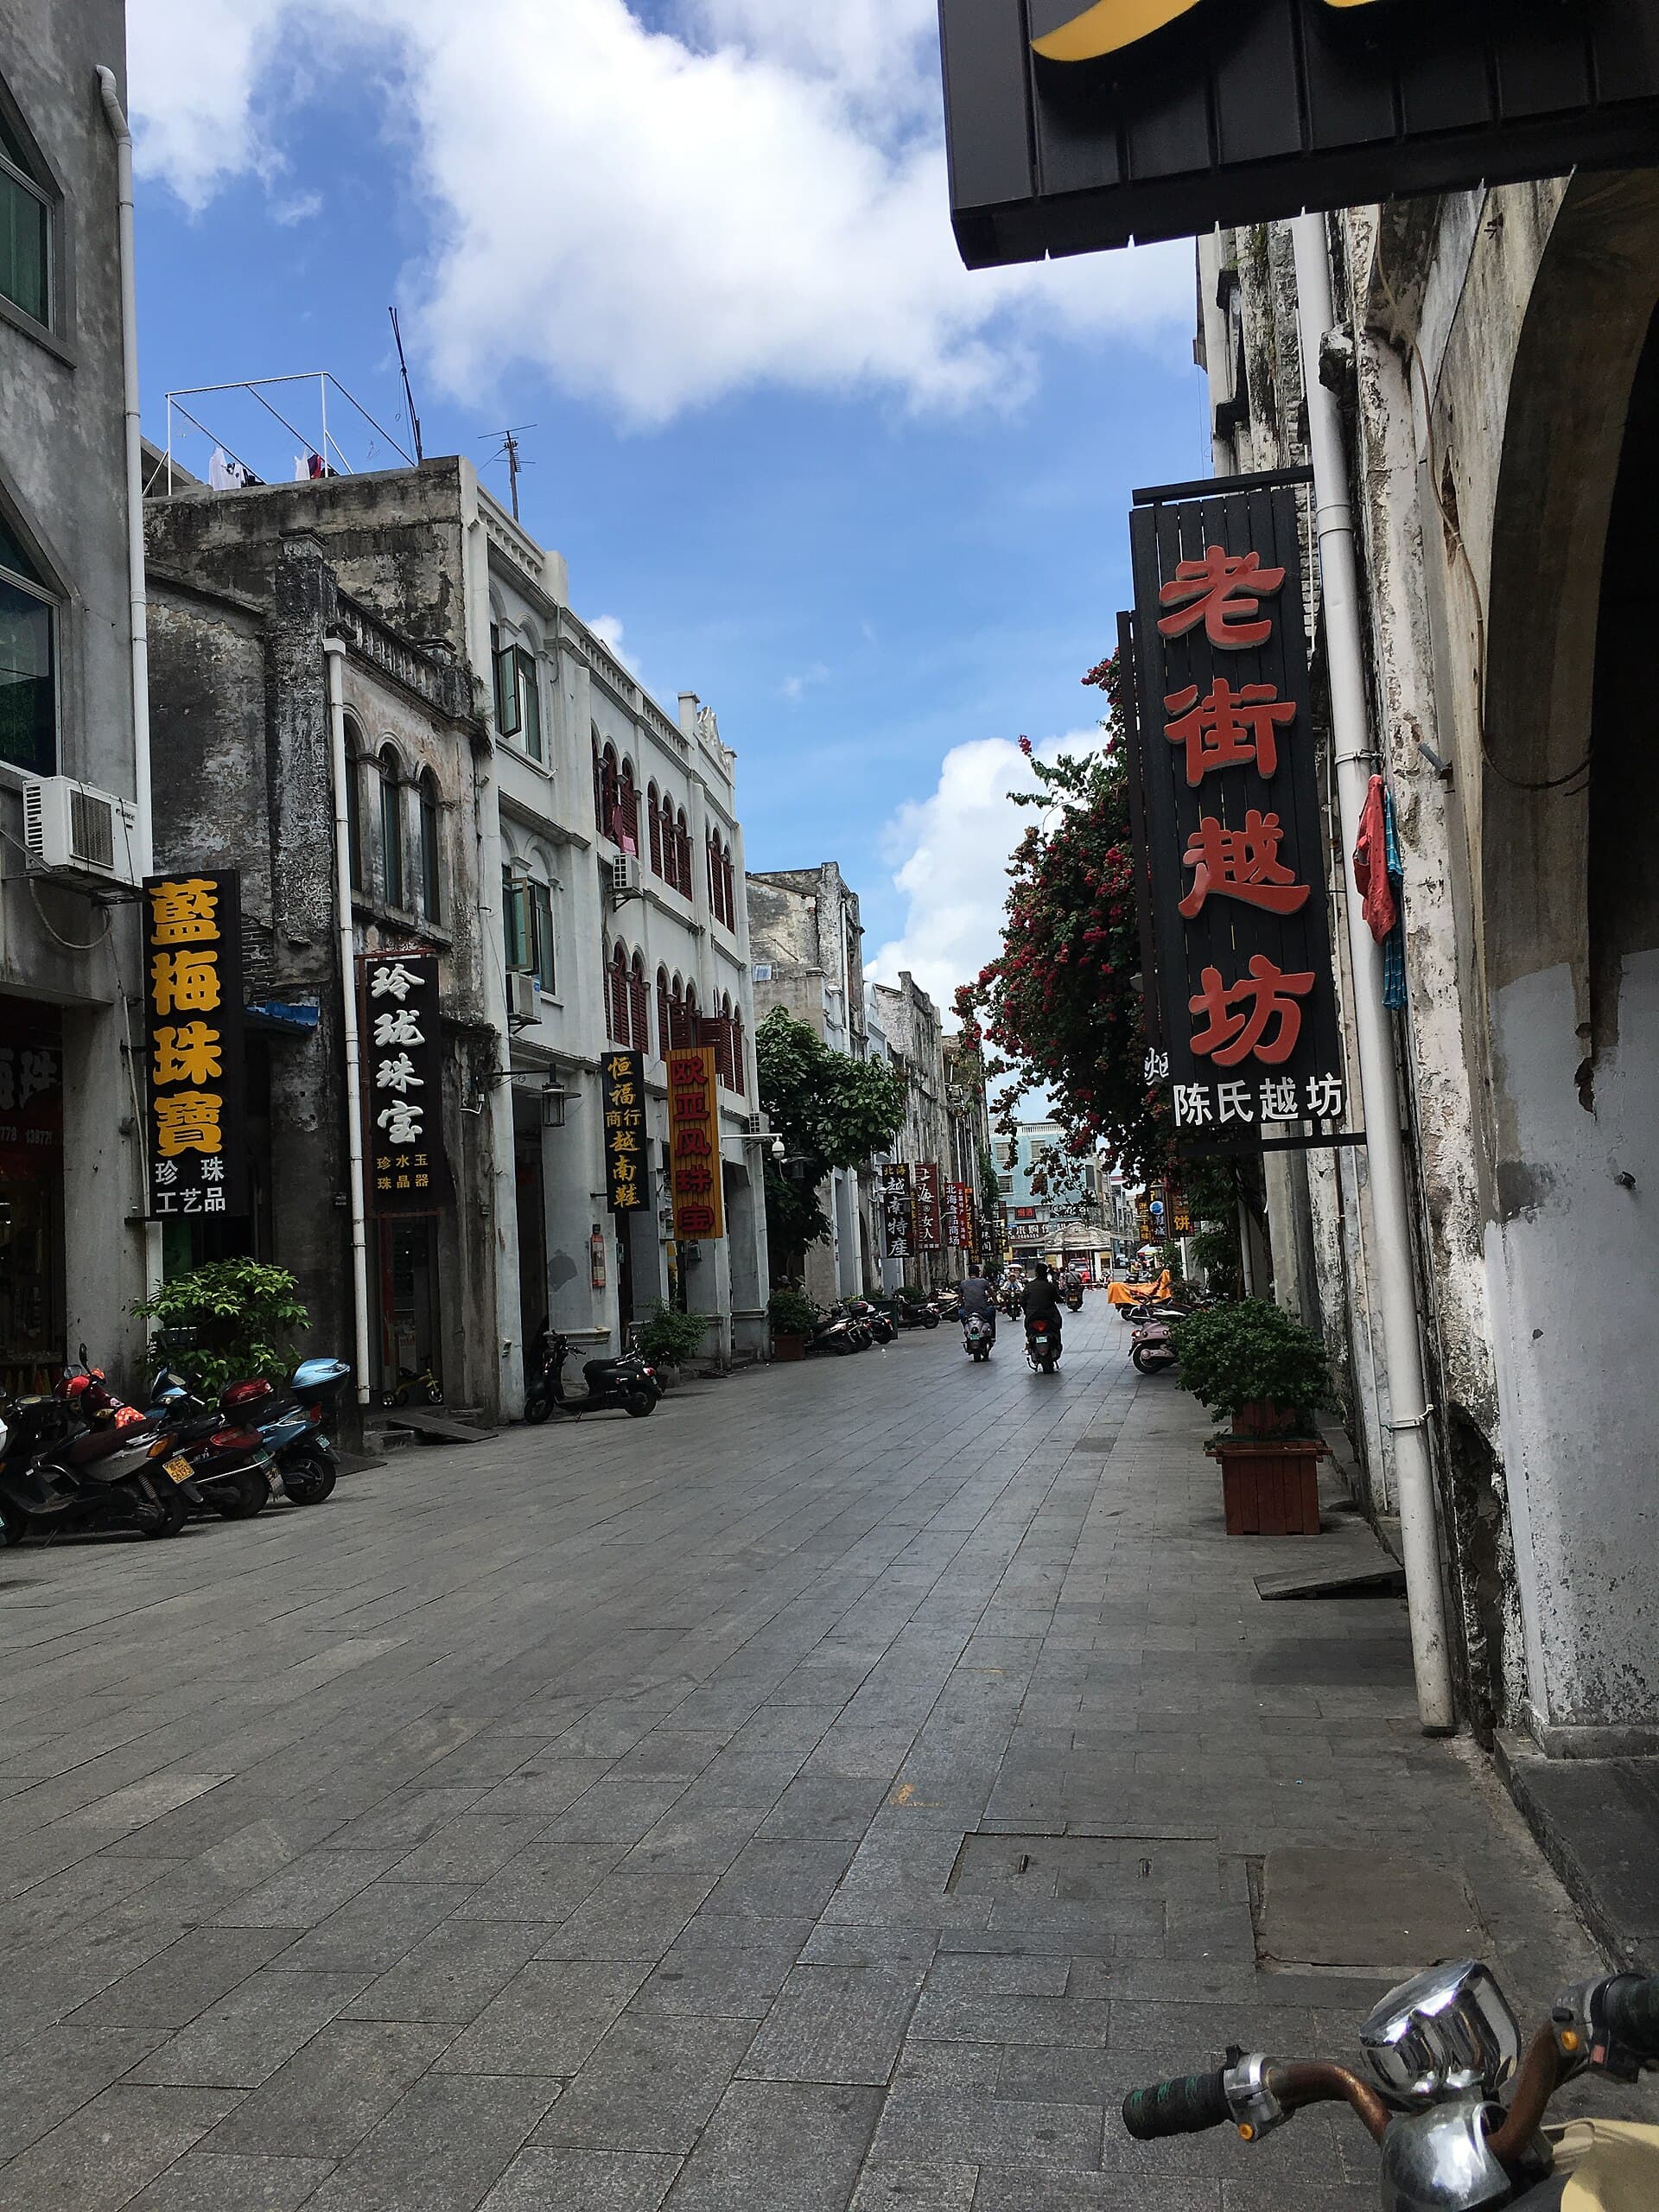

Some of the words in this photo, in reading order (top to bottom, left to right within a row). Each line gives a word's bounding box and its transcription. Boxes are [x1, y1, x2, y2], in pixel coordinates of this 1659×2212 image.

[1159, 544, 1316, 1068] 老街越坊
[149, 878, 223, 1157] 藍梅珠寶
[372, 963, 425, 1144] 玲珑珠宝
[606, 1109, 643, 1128] 商行
[1173, 1072, 1343, 1127] 陈氏越坊
[155, 1156, 225, 1185] 珍珠
[608, 1130, 640, 1209] 越南鞋
[670, 1054, 715, 1232] 欧亚风珠宝
[884, 1166, 906, 1176] 北海
[156, 1186, 226, 1213] 工艺品
